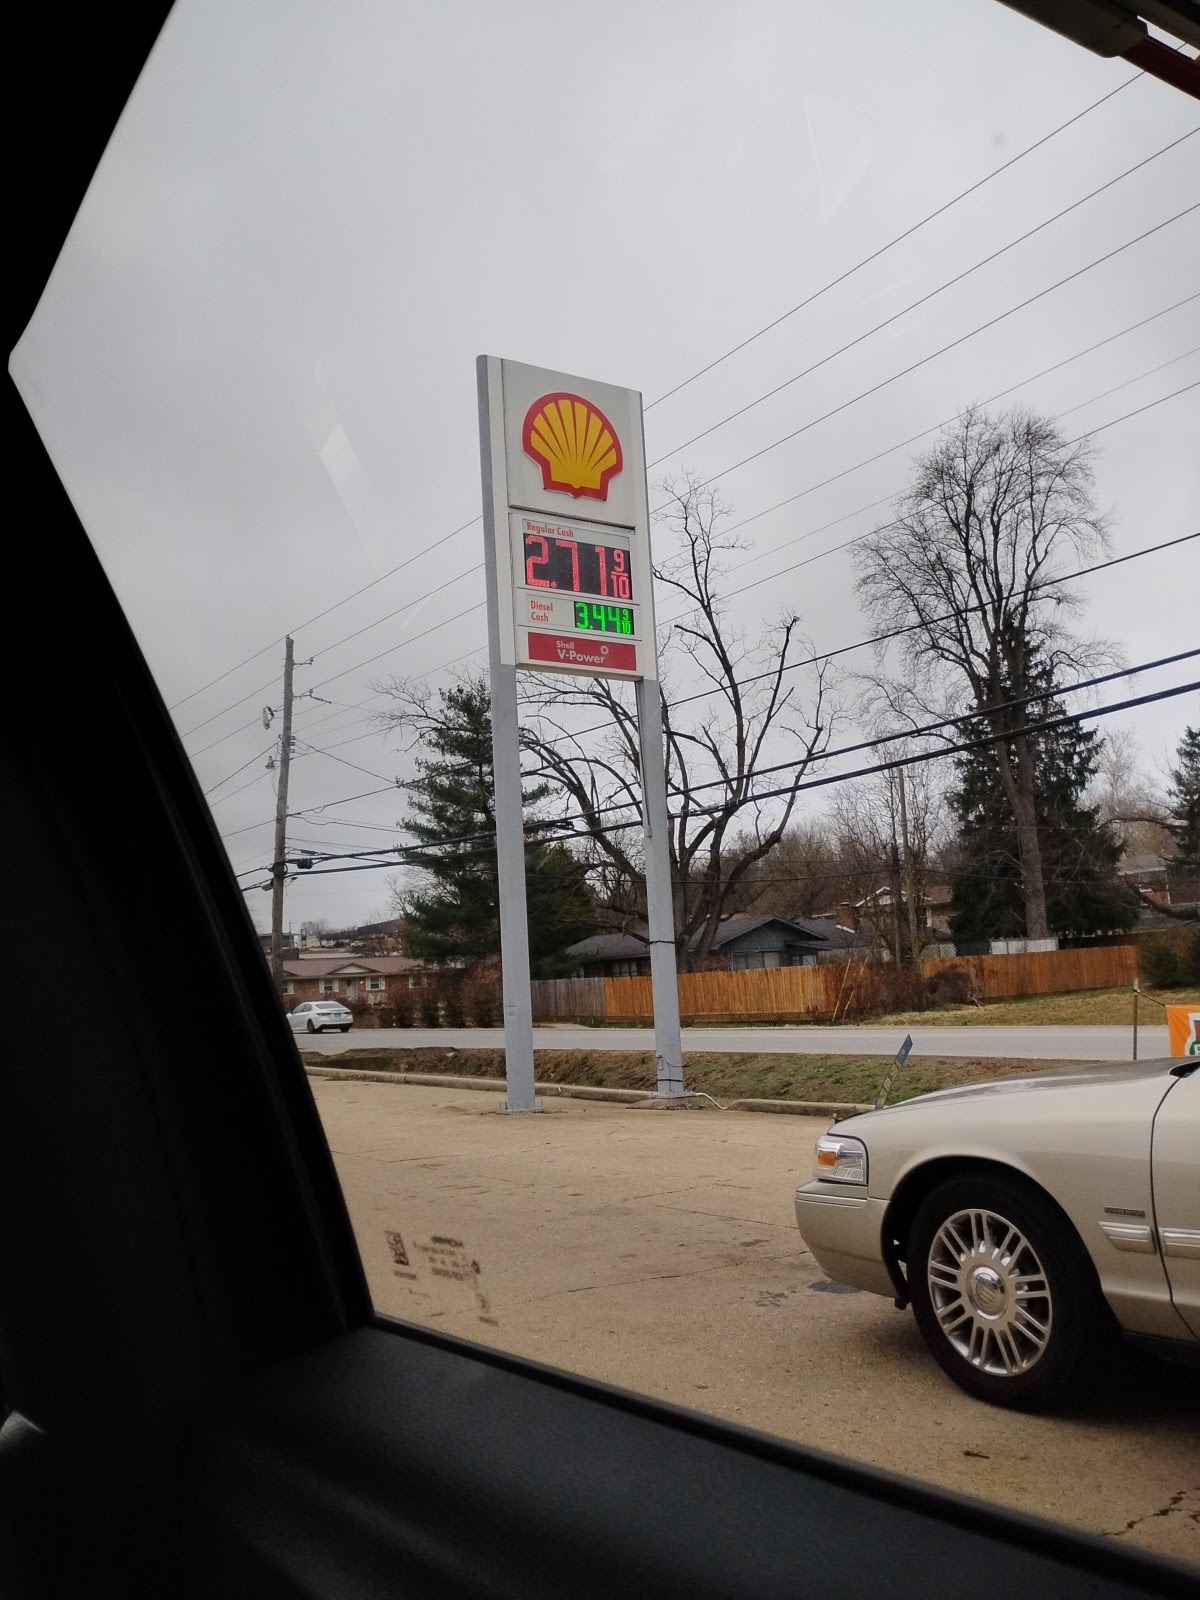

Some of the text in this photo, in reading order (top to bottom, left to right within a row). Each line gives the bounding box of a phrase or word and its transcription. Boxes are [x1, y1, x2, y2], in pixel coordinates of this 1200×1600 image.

[526, 521, 574, 538] Regular Cash
[525, 535, 607, 596] 2.71
[530, 600, 554, 612] Diesel
[531, 612, 549, 623] Cash
[575, 602, 621, 634] 3.44
[556, 640, 575, 650] Shell
[557, 649, 606, 664] V-Power
